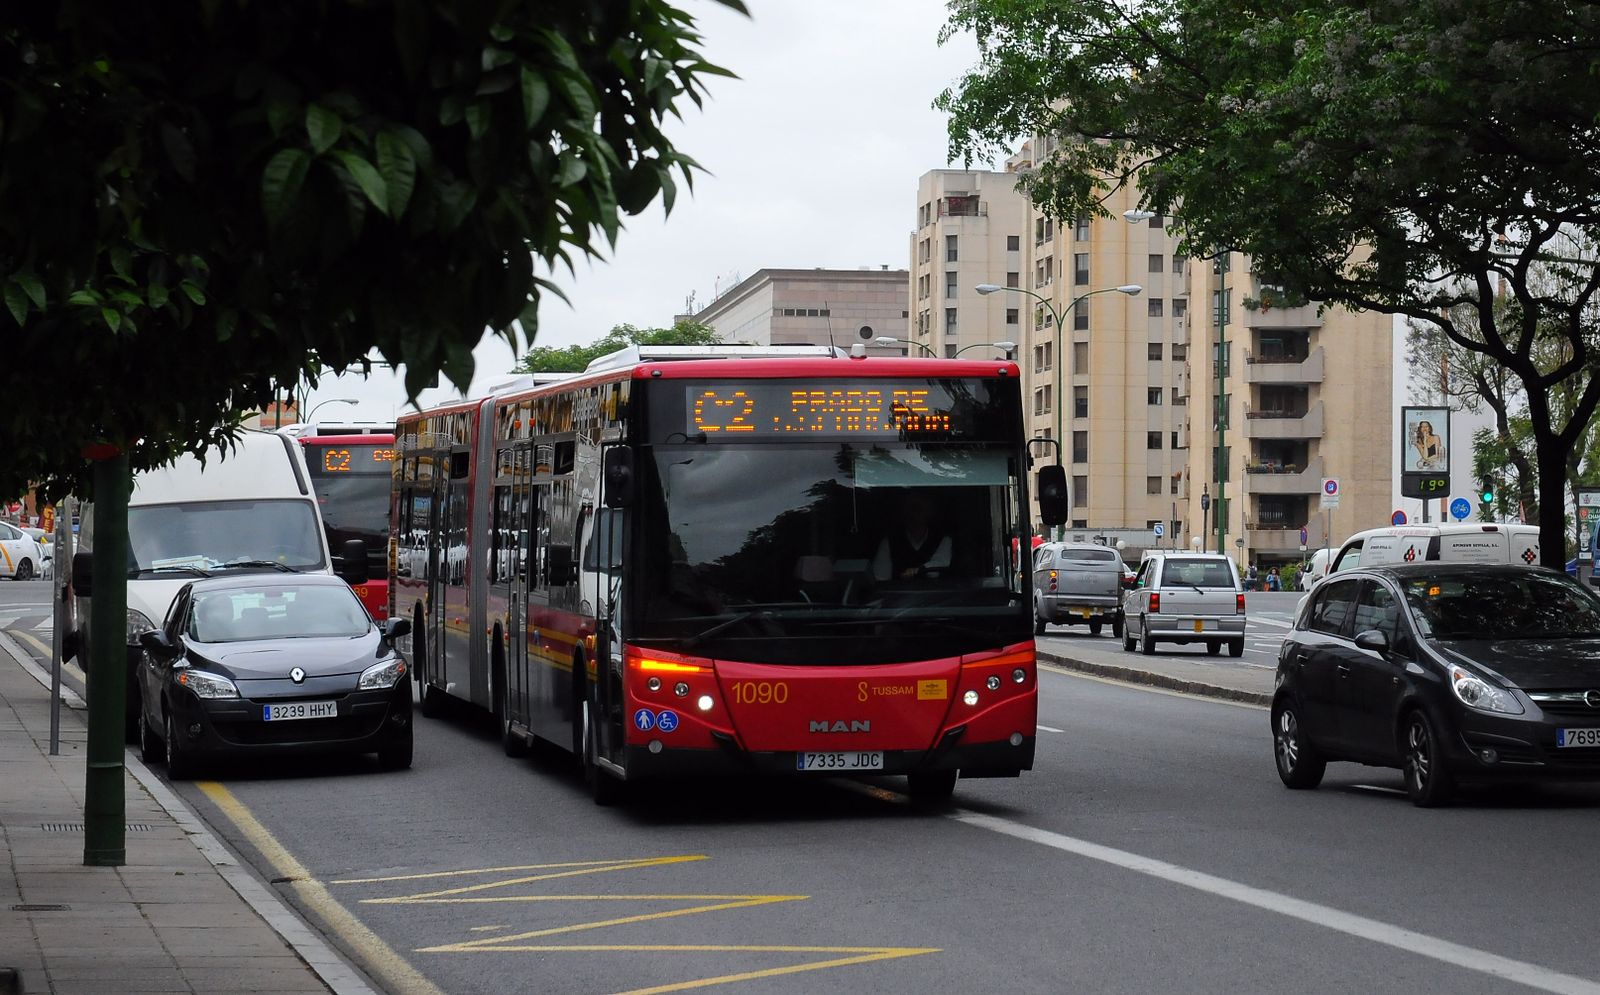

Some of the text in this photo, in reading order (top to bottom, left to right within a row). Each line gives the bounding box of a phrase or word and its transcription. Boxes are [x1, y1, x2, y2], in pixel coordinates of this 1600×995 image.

[695, 391, 755, 432] C2
[325, 449, 351, 471] C2
[731, 682, 788, 704] 1090
[871, 686, 914, 696] TUSSAM
[273, 703, 333, 719] 3239 HHY
[809, 720, 870, 732] MAN
[807, 753, 880, 767] 7335 JDC
